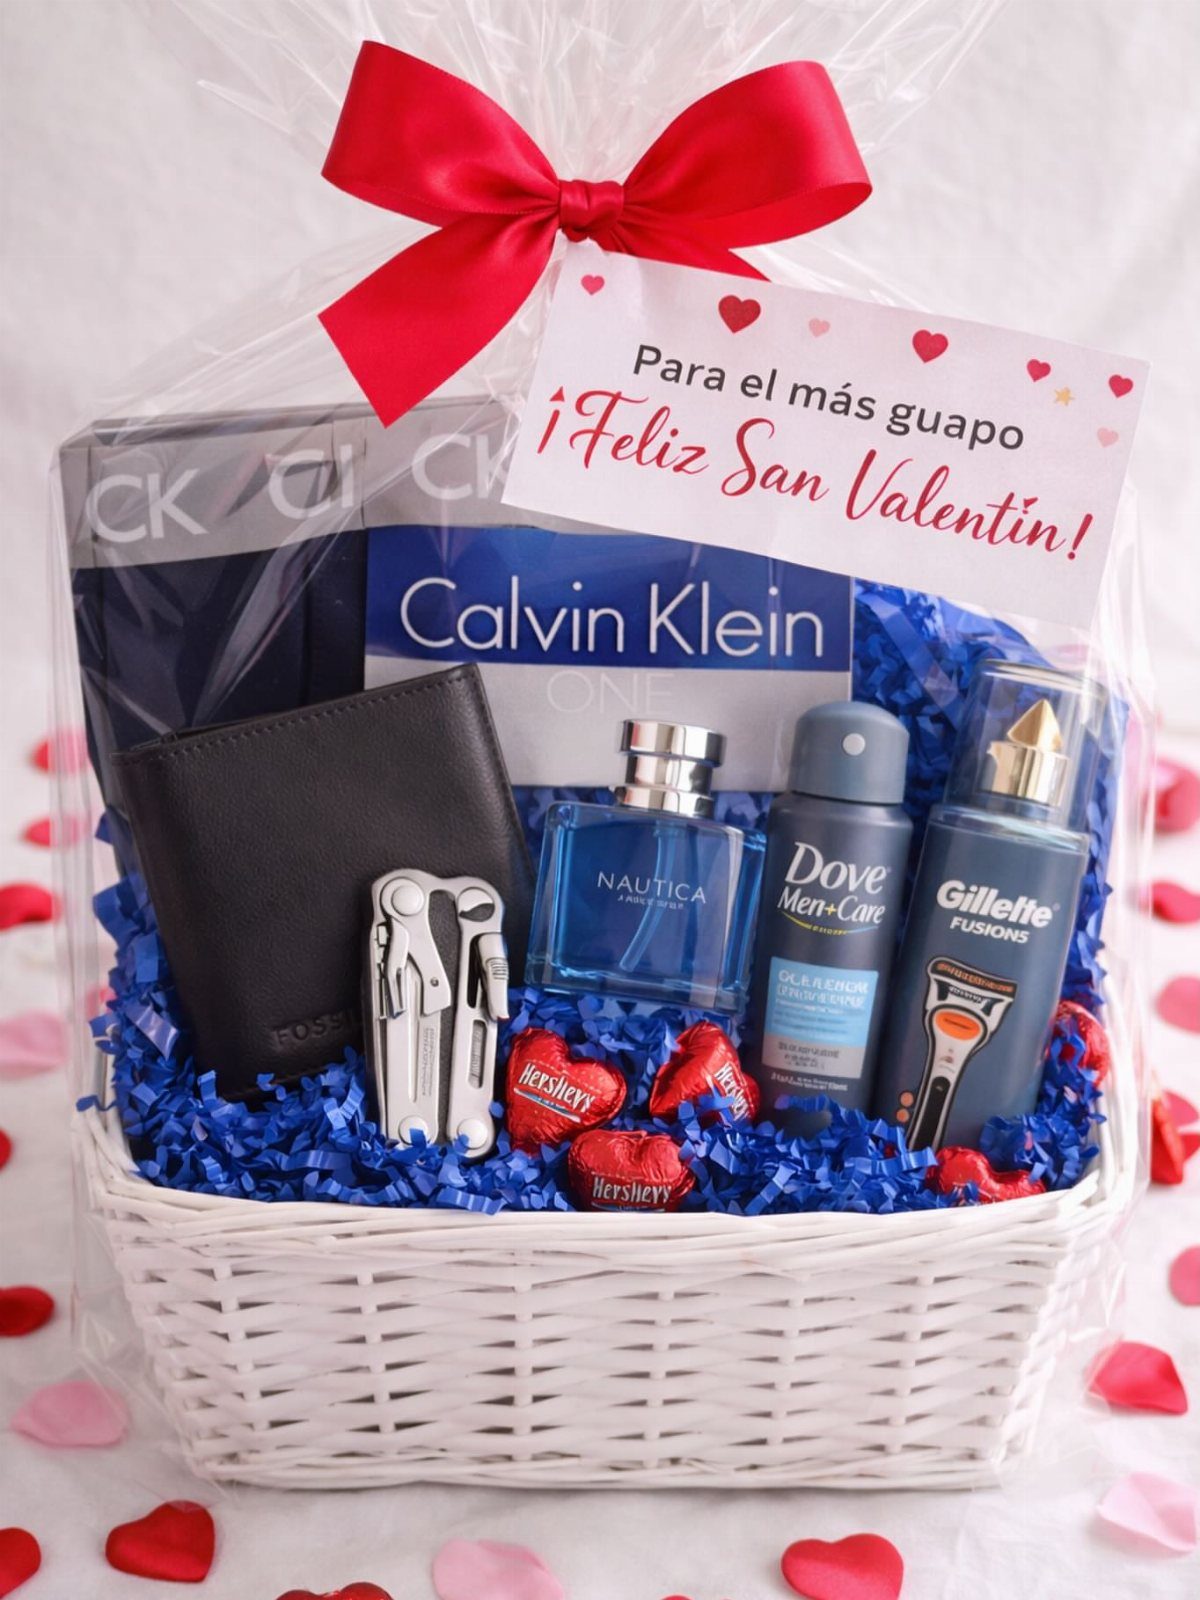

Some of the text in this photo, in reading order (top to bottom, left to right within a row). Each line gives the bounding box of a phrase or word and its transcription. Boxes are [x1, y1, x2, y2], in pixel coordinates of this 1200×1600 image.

[633, 344, 1025, 451] Para el más guapo
[719, 417, 830, 504] San
[87, 467, 208, 543] CK
[401, 575, 824, 657] Calvin Klein
[546, 668, 676, 715] ONE
[597, 871, 707, 905] NAUTICA
[785, 841, 887, 894] Dove
[936, 879, 1054, 929] Gillette
